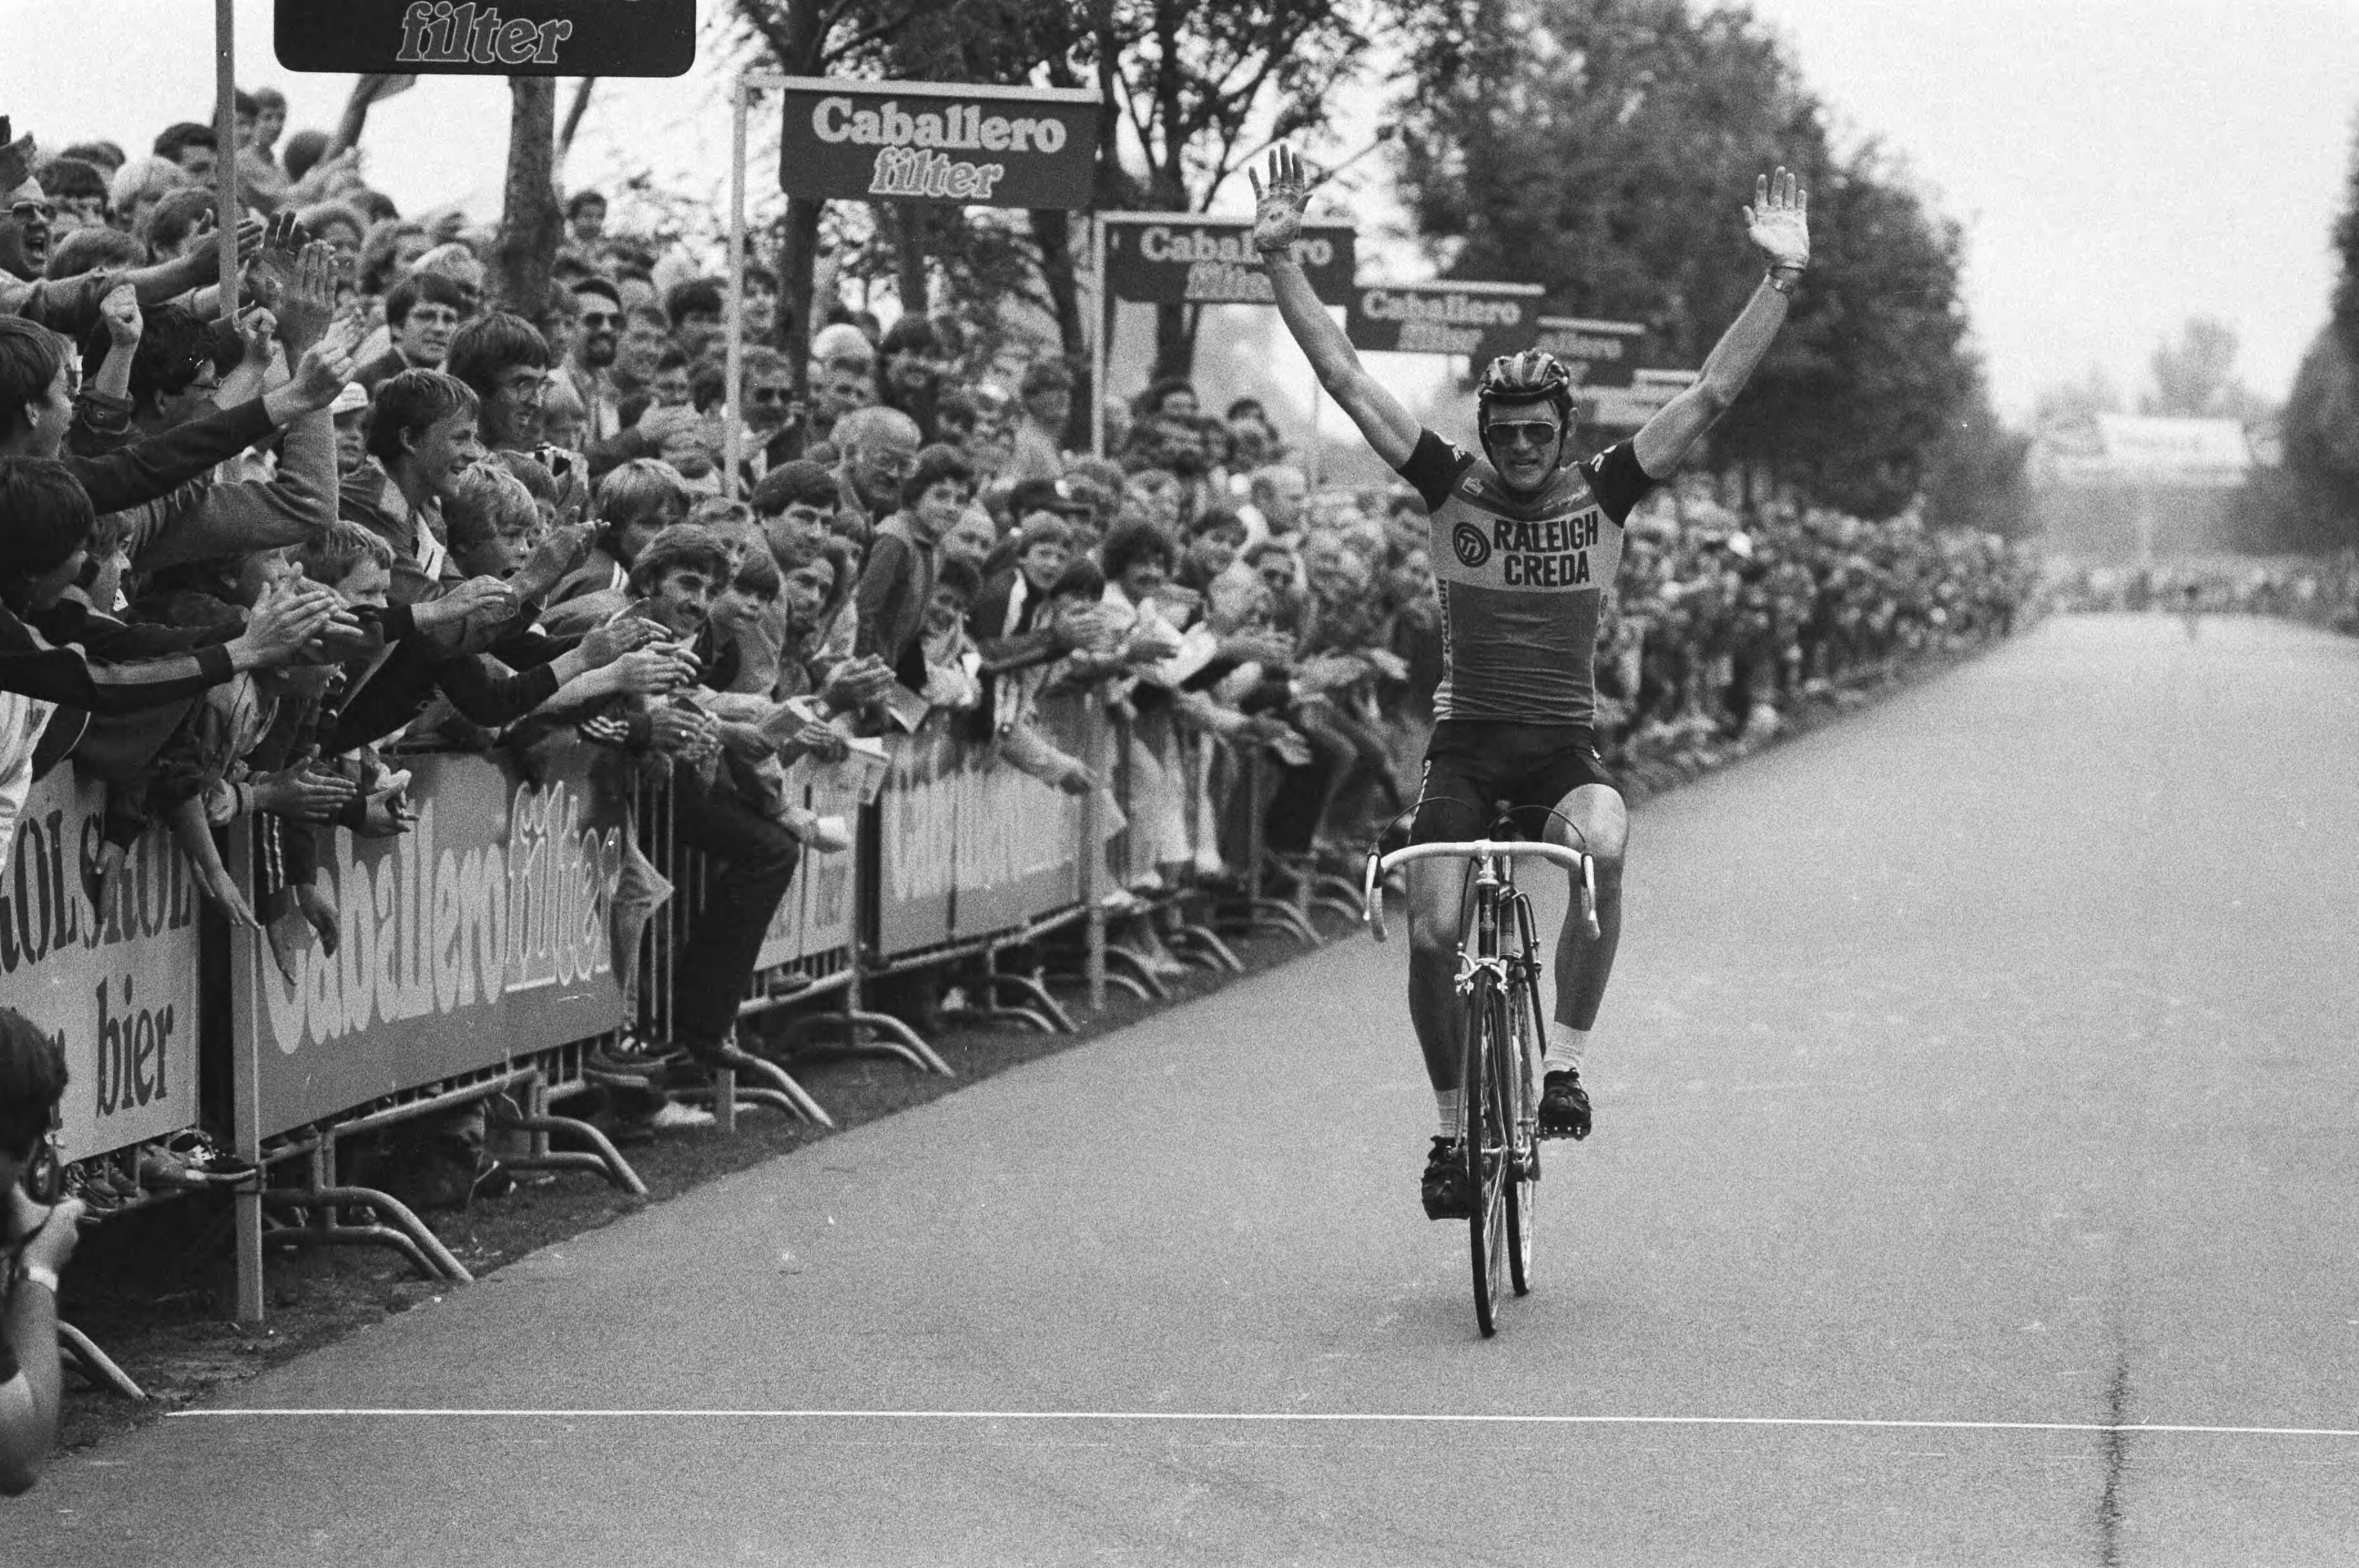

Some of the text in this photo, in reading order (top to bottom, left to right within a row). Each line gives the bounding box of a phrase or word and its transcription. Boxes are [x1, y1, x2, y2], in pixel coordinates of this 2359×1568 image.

[396, 1, 573, 64] filter
[812, 97, 1067, 153] Caballero
[869, 146, 1004, 199] filter
[1140, 226, 1333, 266] Cabalro
[1362, 290, 1521, 326] Caballero
[1494, 510, 1599, 552] RALEIGH
[1505, 550, 1590, 587] CREDA
[96, 974, 174, 1118] bier
